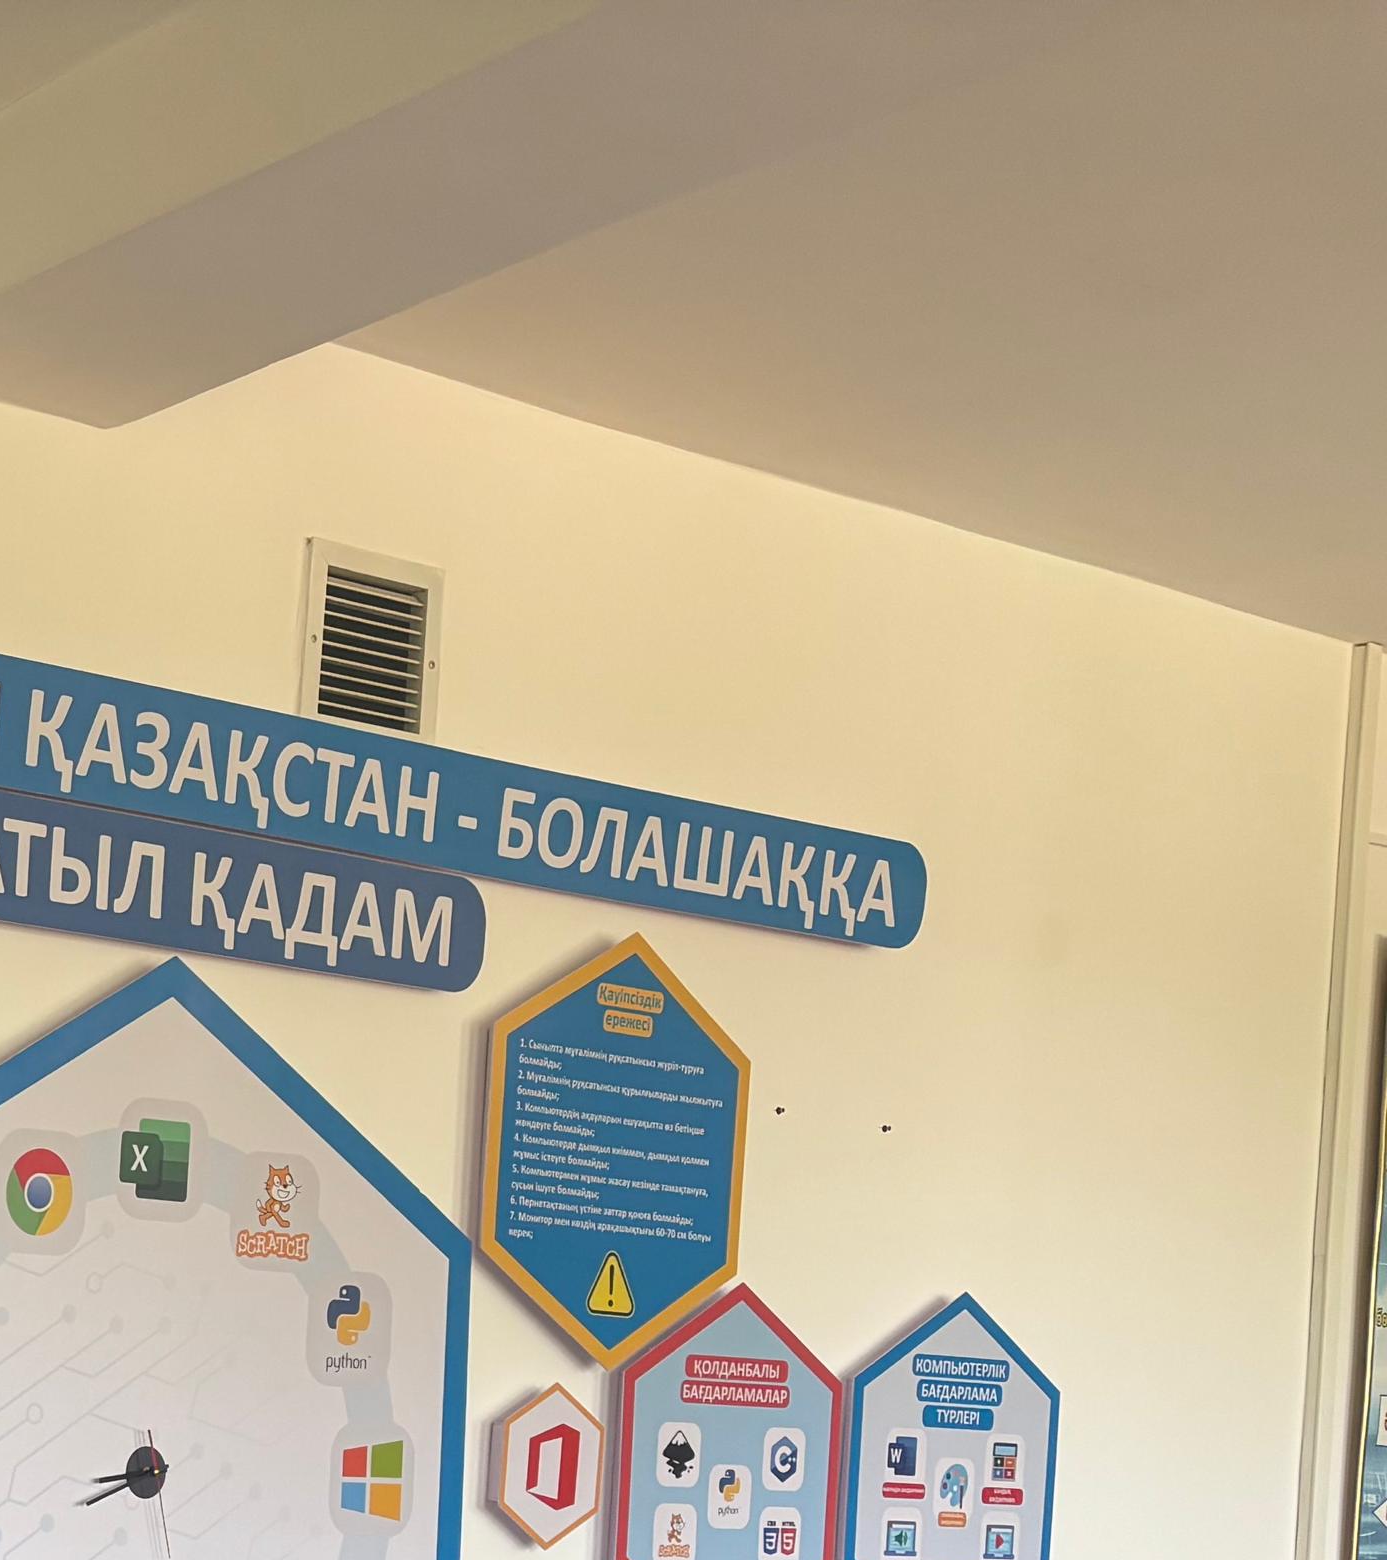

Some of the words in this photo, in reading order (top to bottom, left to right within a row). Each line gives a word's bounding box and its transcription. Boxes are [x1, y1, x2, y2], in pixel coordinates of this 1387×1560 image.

[25, 689, 439, 843] ҚАЗАҚСТАН
[457, 814, 478, 829] -
[498, 789, 896, 935] БОЛАШАҚҚА
[190, 852, 453, 967] ҚАДАМ
[606, 1015, 651, 1031] ережесі
[520, 1038, 527, 1048] 1.
[129, 1144, 149, 1173] X
[510, 1195, 517, 1205] 6.
[509, 1211, 516, 1220] 7.
[655, 1227, 676, 1238] 60-70
[236, 1231, 310, 1261] SCRATCH
[325, 1351, 368, 1373] python
[693, 1358, 780, 1380] ҚОЛДАНБАЛЫ
[915, 1357, 1007, 1379] КОМПЬЮТЕРЛІК
[682, 1383, 788, 1404] БАҒДАРЛАМАЛАР
[921, 1383, 998, 1404] БАҒДАРЛАМА
[936, 1408, 981, 1427] ТҮРЛЕРІ
[890, 1448, 902, 1463] W
[717, 1506, 739, 1517] python
[783, 1533, 794, 1550] 5
